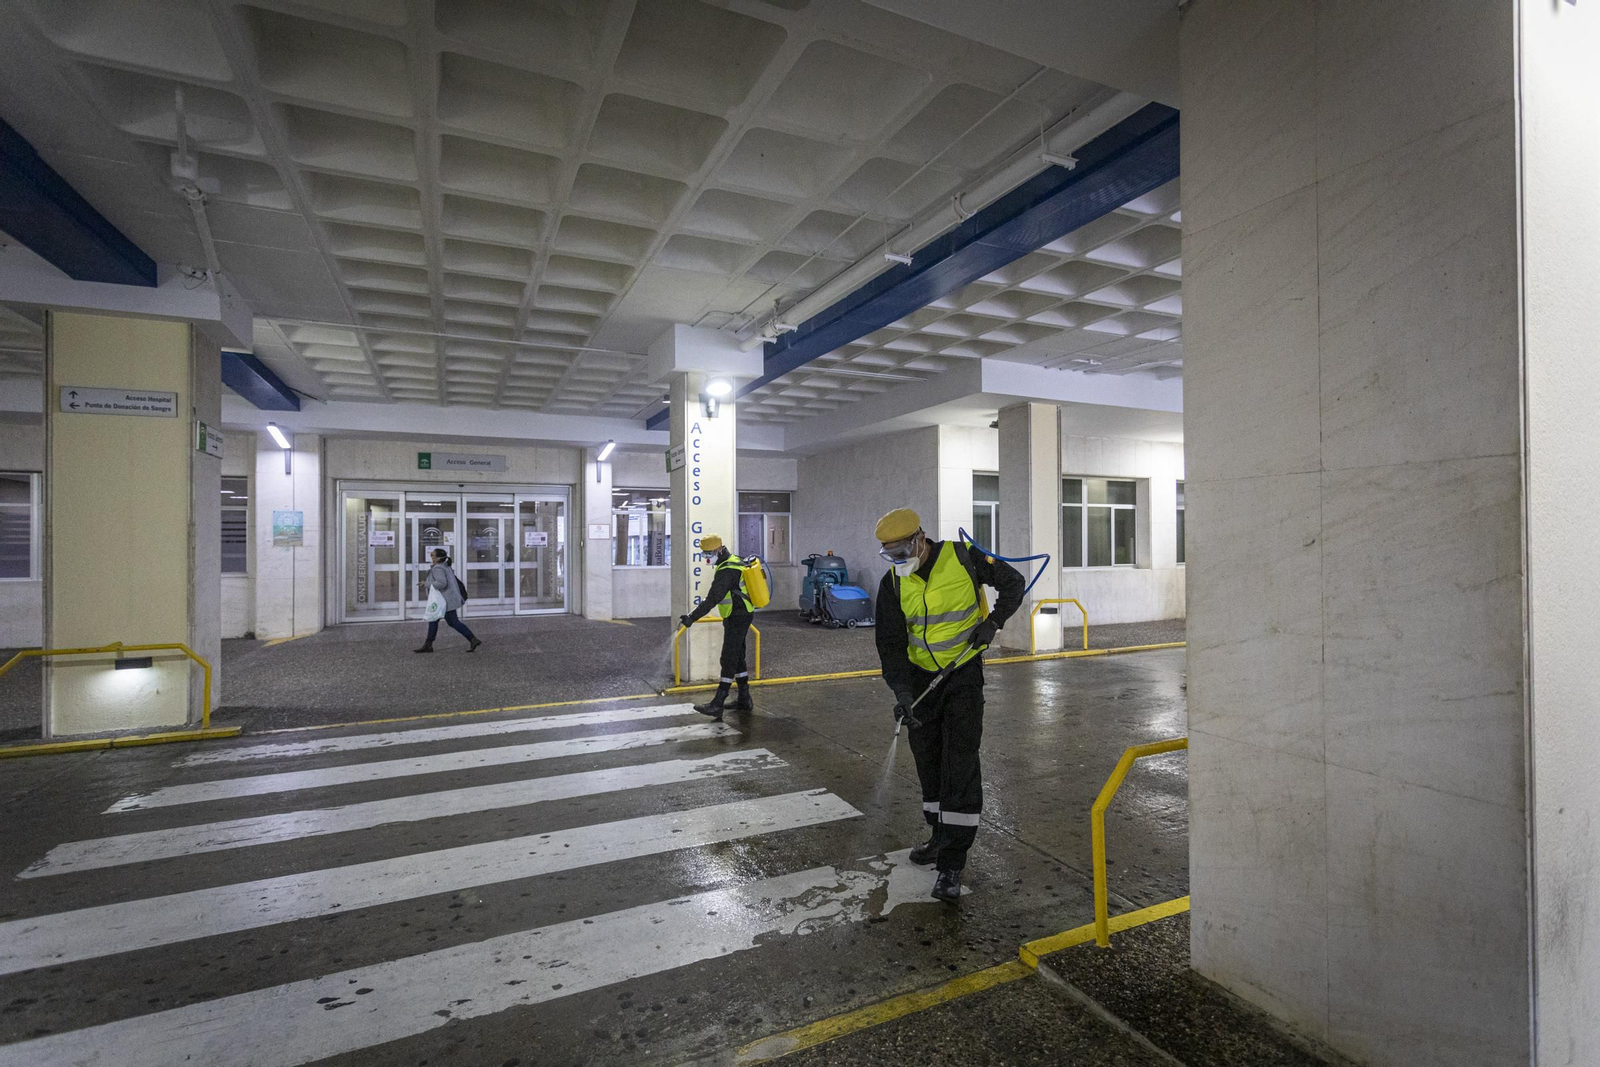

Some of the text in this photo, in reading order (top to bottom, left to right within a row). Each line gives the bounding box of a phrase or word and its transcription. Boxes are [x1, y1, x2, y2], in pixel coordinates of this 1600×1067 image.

[358, 514, 366, 541] SALUD
[690, 422, 703, 606] Acceso Genera
[357, 556, 366, 603] ONSEJERÍA
